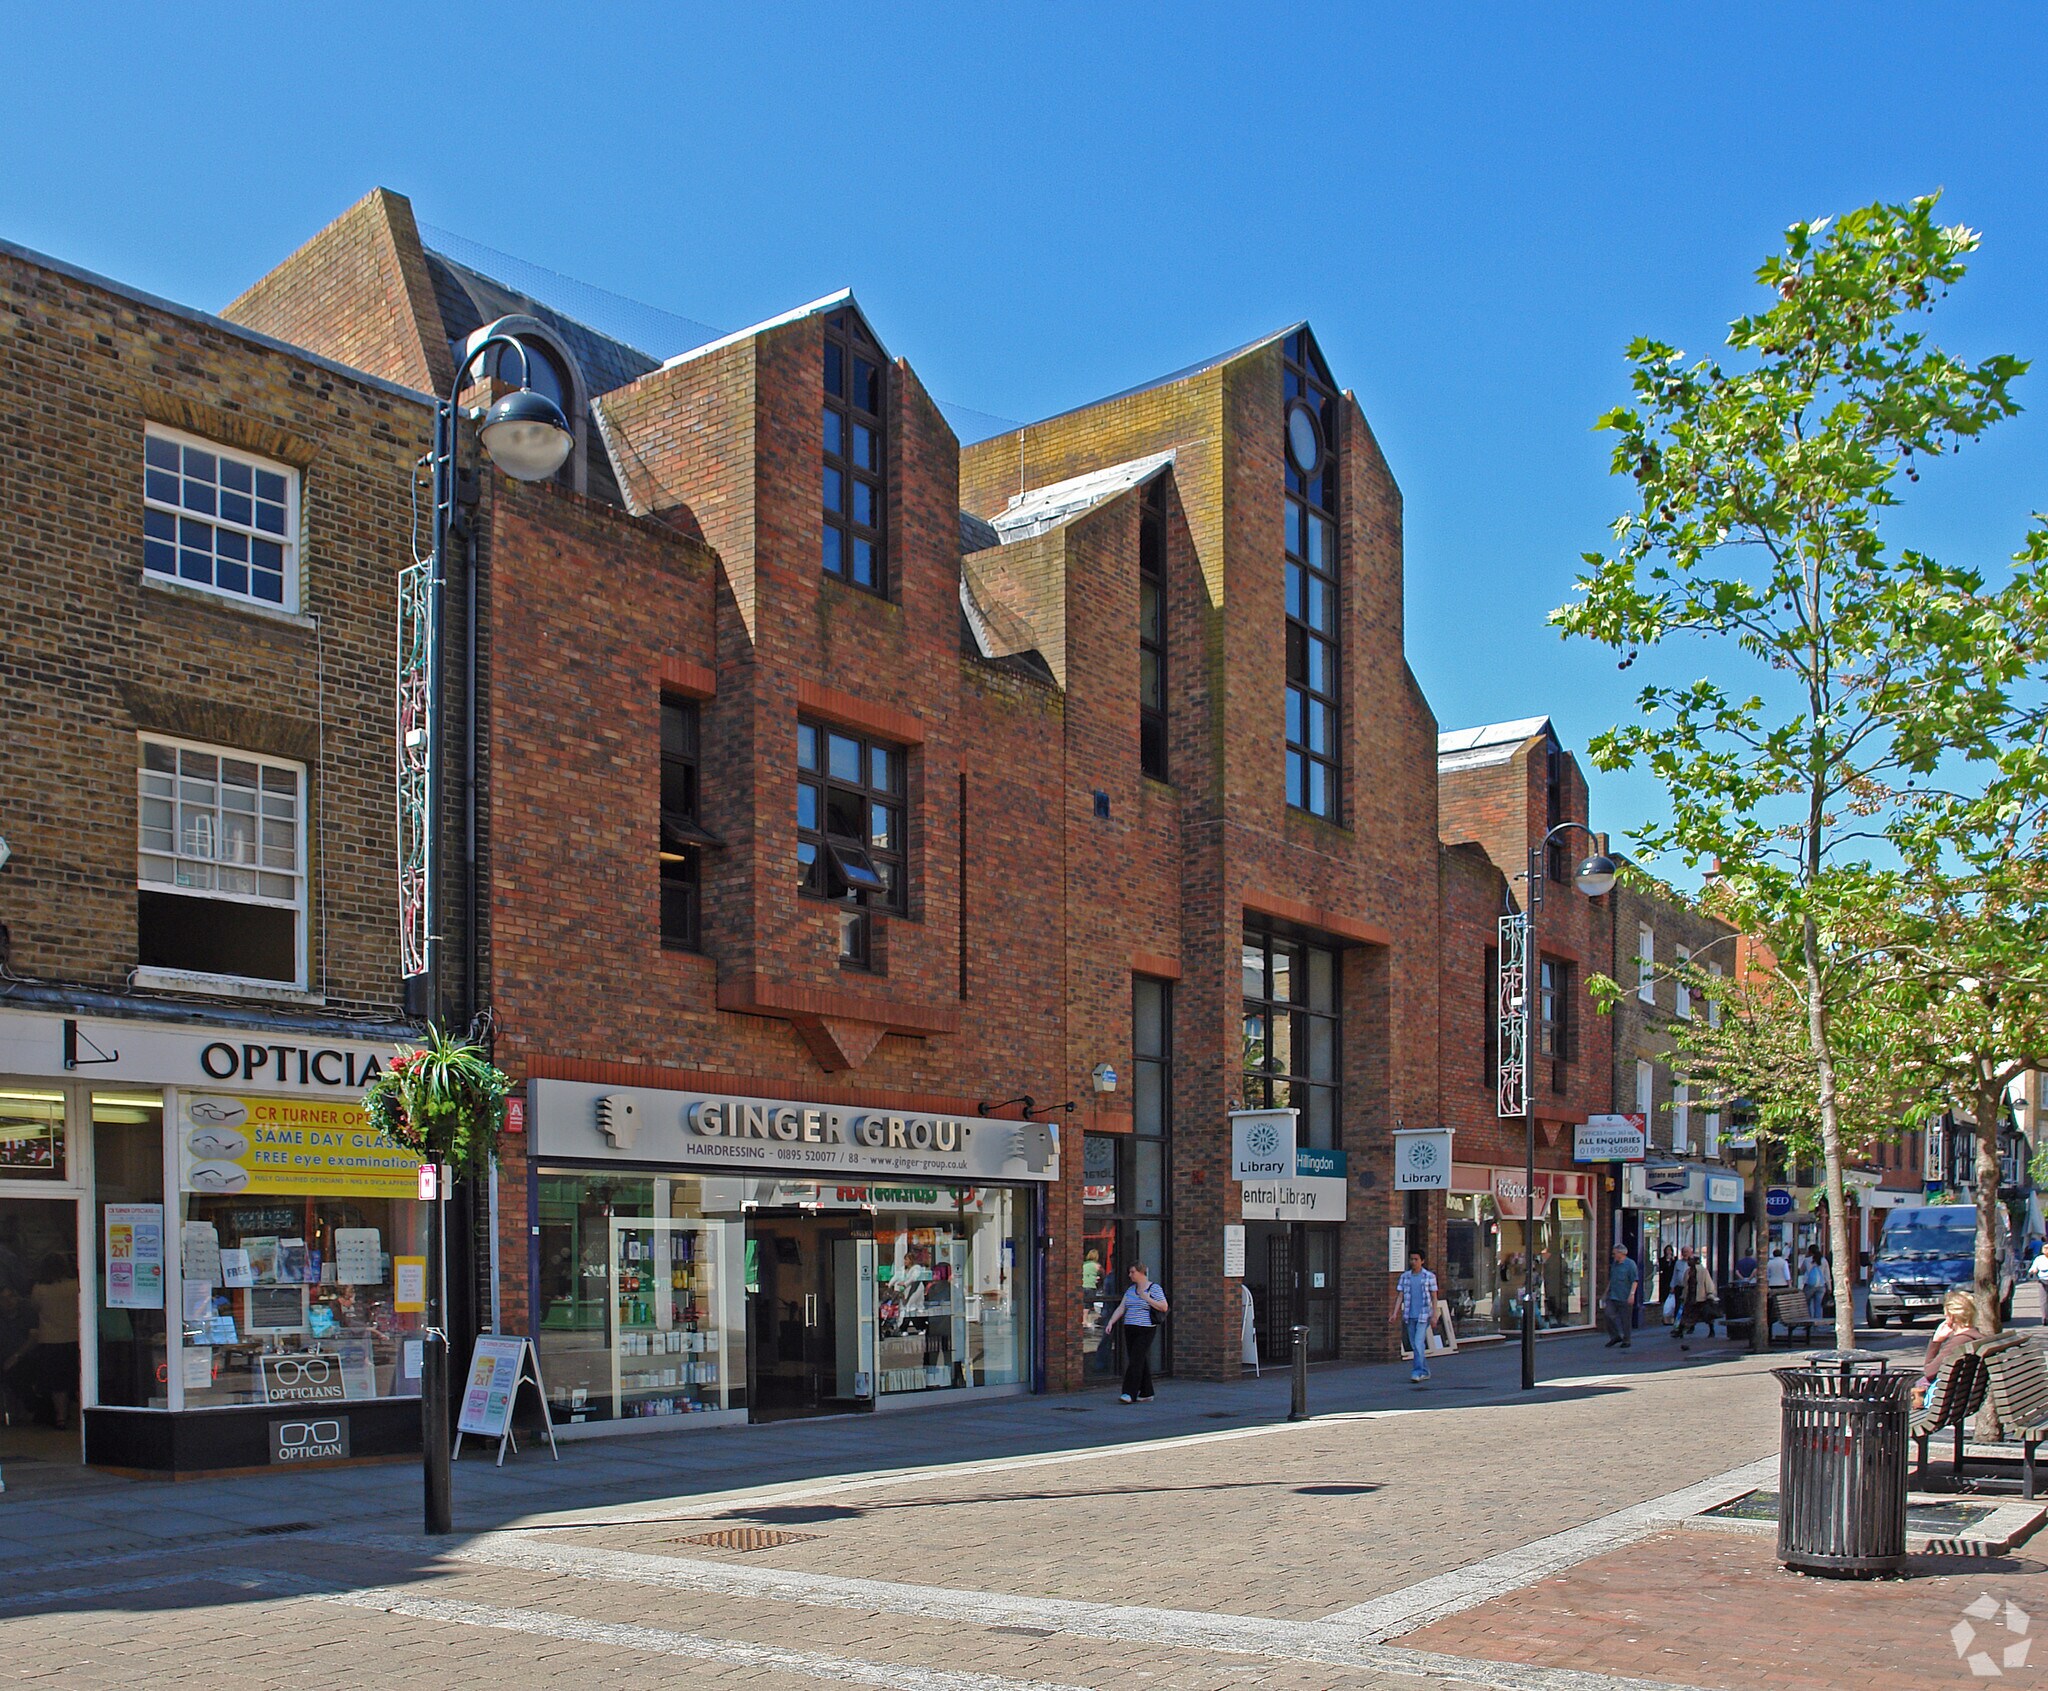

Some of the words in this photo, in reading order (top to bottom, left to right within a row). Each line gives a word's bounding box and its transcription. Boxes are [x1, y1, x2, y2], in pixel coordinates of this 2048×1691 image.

[201, 1042, 393, 1087] OPTICIA
[255, 1106, 277, 1121] CR
[282, 1107, 337, 1124] TURNER
[689, 1100, 844, 1144] GINGER
[854, 1114, 972, 1151] GROUP
[254, 1129, 303, 1144] SAME
[310, 1131, 344, 1146] DAY
[1596, 1136, 1641, 1145] ENQUIRIES
[687, 1143, 765, 1159] HAIRDRESSING
[777, 1149, 801, 1161] 01895
[805, 1150, 836, 1163] 520077
[848, 1153, 859, 1164] 88
[870, 1155, 968, 1171] www.ginger-group.co.uk
[1608, 1146, 1639, 1154] 450800
[255, 1150, 288, 1164] FREE
[294, 1154, 321, 1167] eye
[1296, 1154, 1334, 1173] Hillingdon
[1240, 1161, 1284, 1174] Library
[275, 1175, 309, 1183] QUALIFIED
[1402, 1173, 1442, 1185] Library
[1243, 1187, 1276, 1204] entral
[1280, 1187, 1317, 1210] Library
[1766, 1196, 1789, 1205] REED
[112, 1244, 129, 1258] 2x1
[227, 1266, 248, 1278] FREE
[270, 1385, 342, 1400] OPTICIANS
[278, 1443, 341, 1460] OPTICIAN
